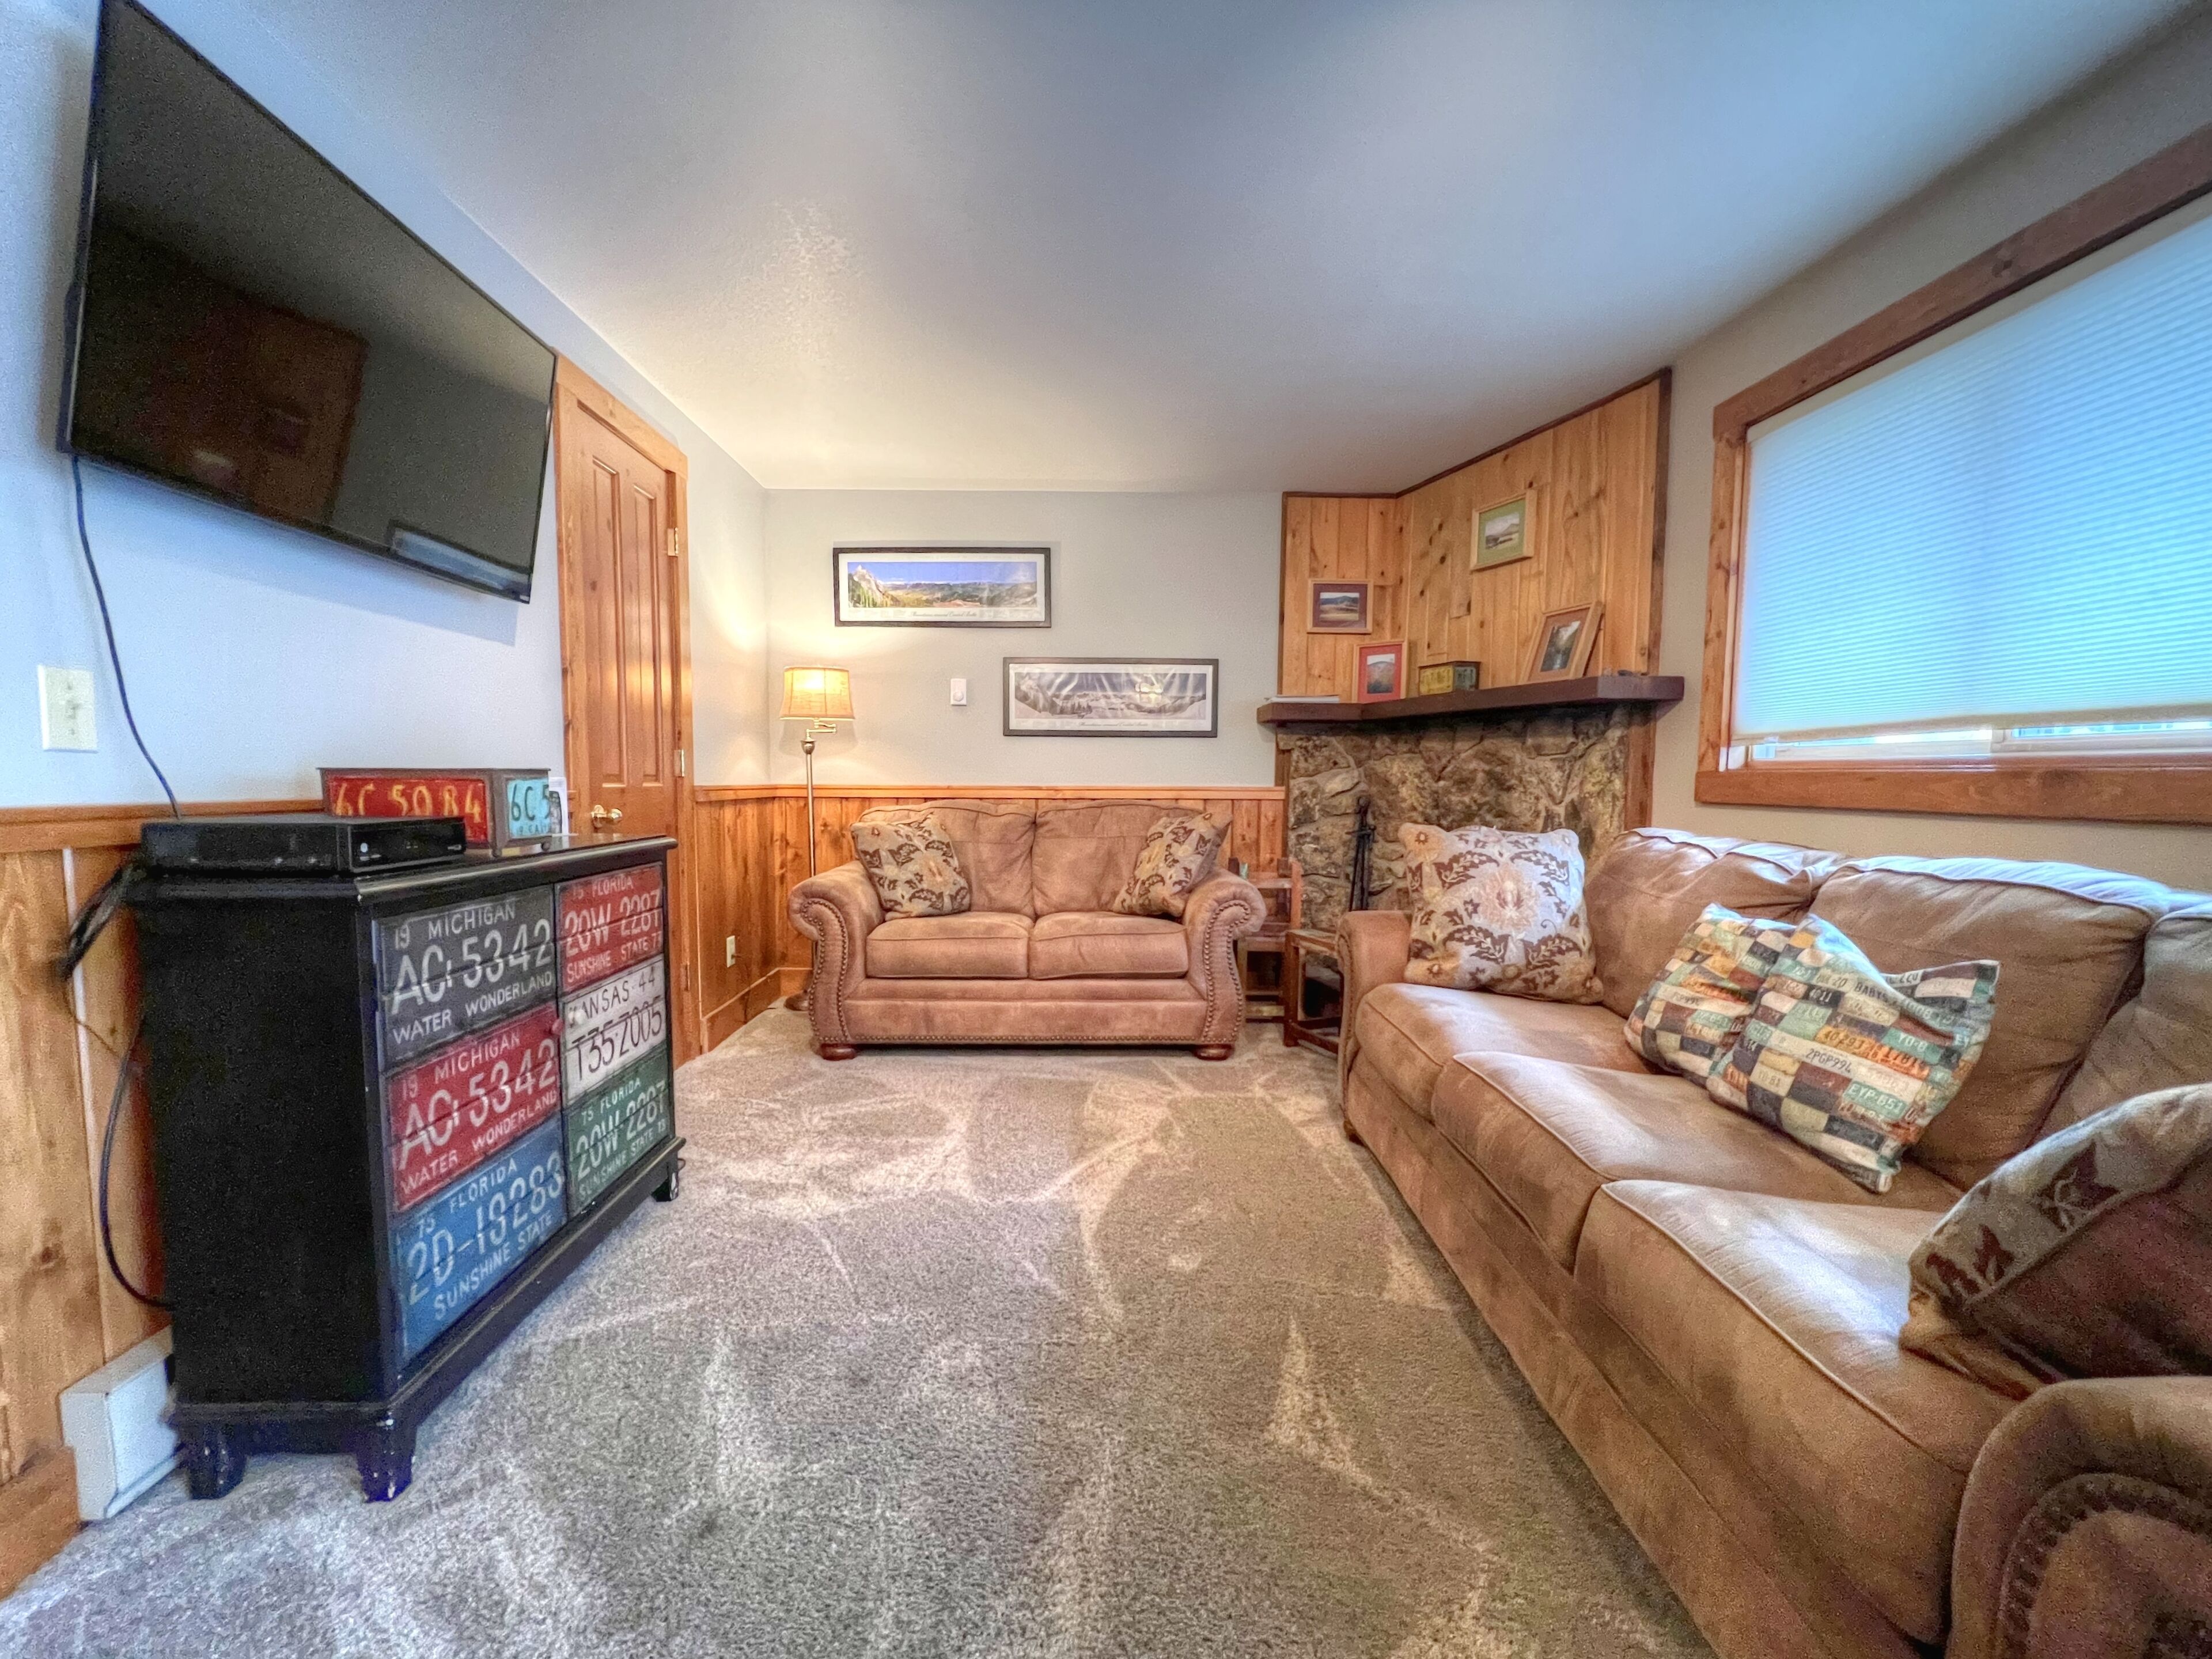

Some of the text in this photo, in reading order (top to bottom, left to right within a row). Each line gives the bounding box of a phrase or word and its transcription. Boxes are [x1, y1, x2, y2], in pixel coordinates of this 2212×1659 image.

[592, 874, 634, 897] FLORIDA
[395, 903, 516, 949] 19 MICHIGAN
[567, 950, 611, 983] SUNSHINE
[620, 935, 649, 960] STATE
[392, 971, 552, 1044] WATER WONDERLAND
[403, 1032, 520, 1100] 19 MICHIGAN
[600, 1077, 642, 1114] FLORIDA
[401, 1089, 558, 1195] WATER WONDERLAND
[578, 1150, 627, 1201] SUNSHINE
[631, 1127, 654, 1157] STATE
[450, 1157, 518, 1213] FLORIDA
[434, 1209, 553, 1320] SUNSHINE STATE
